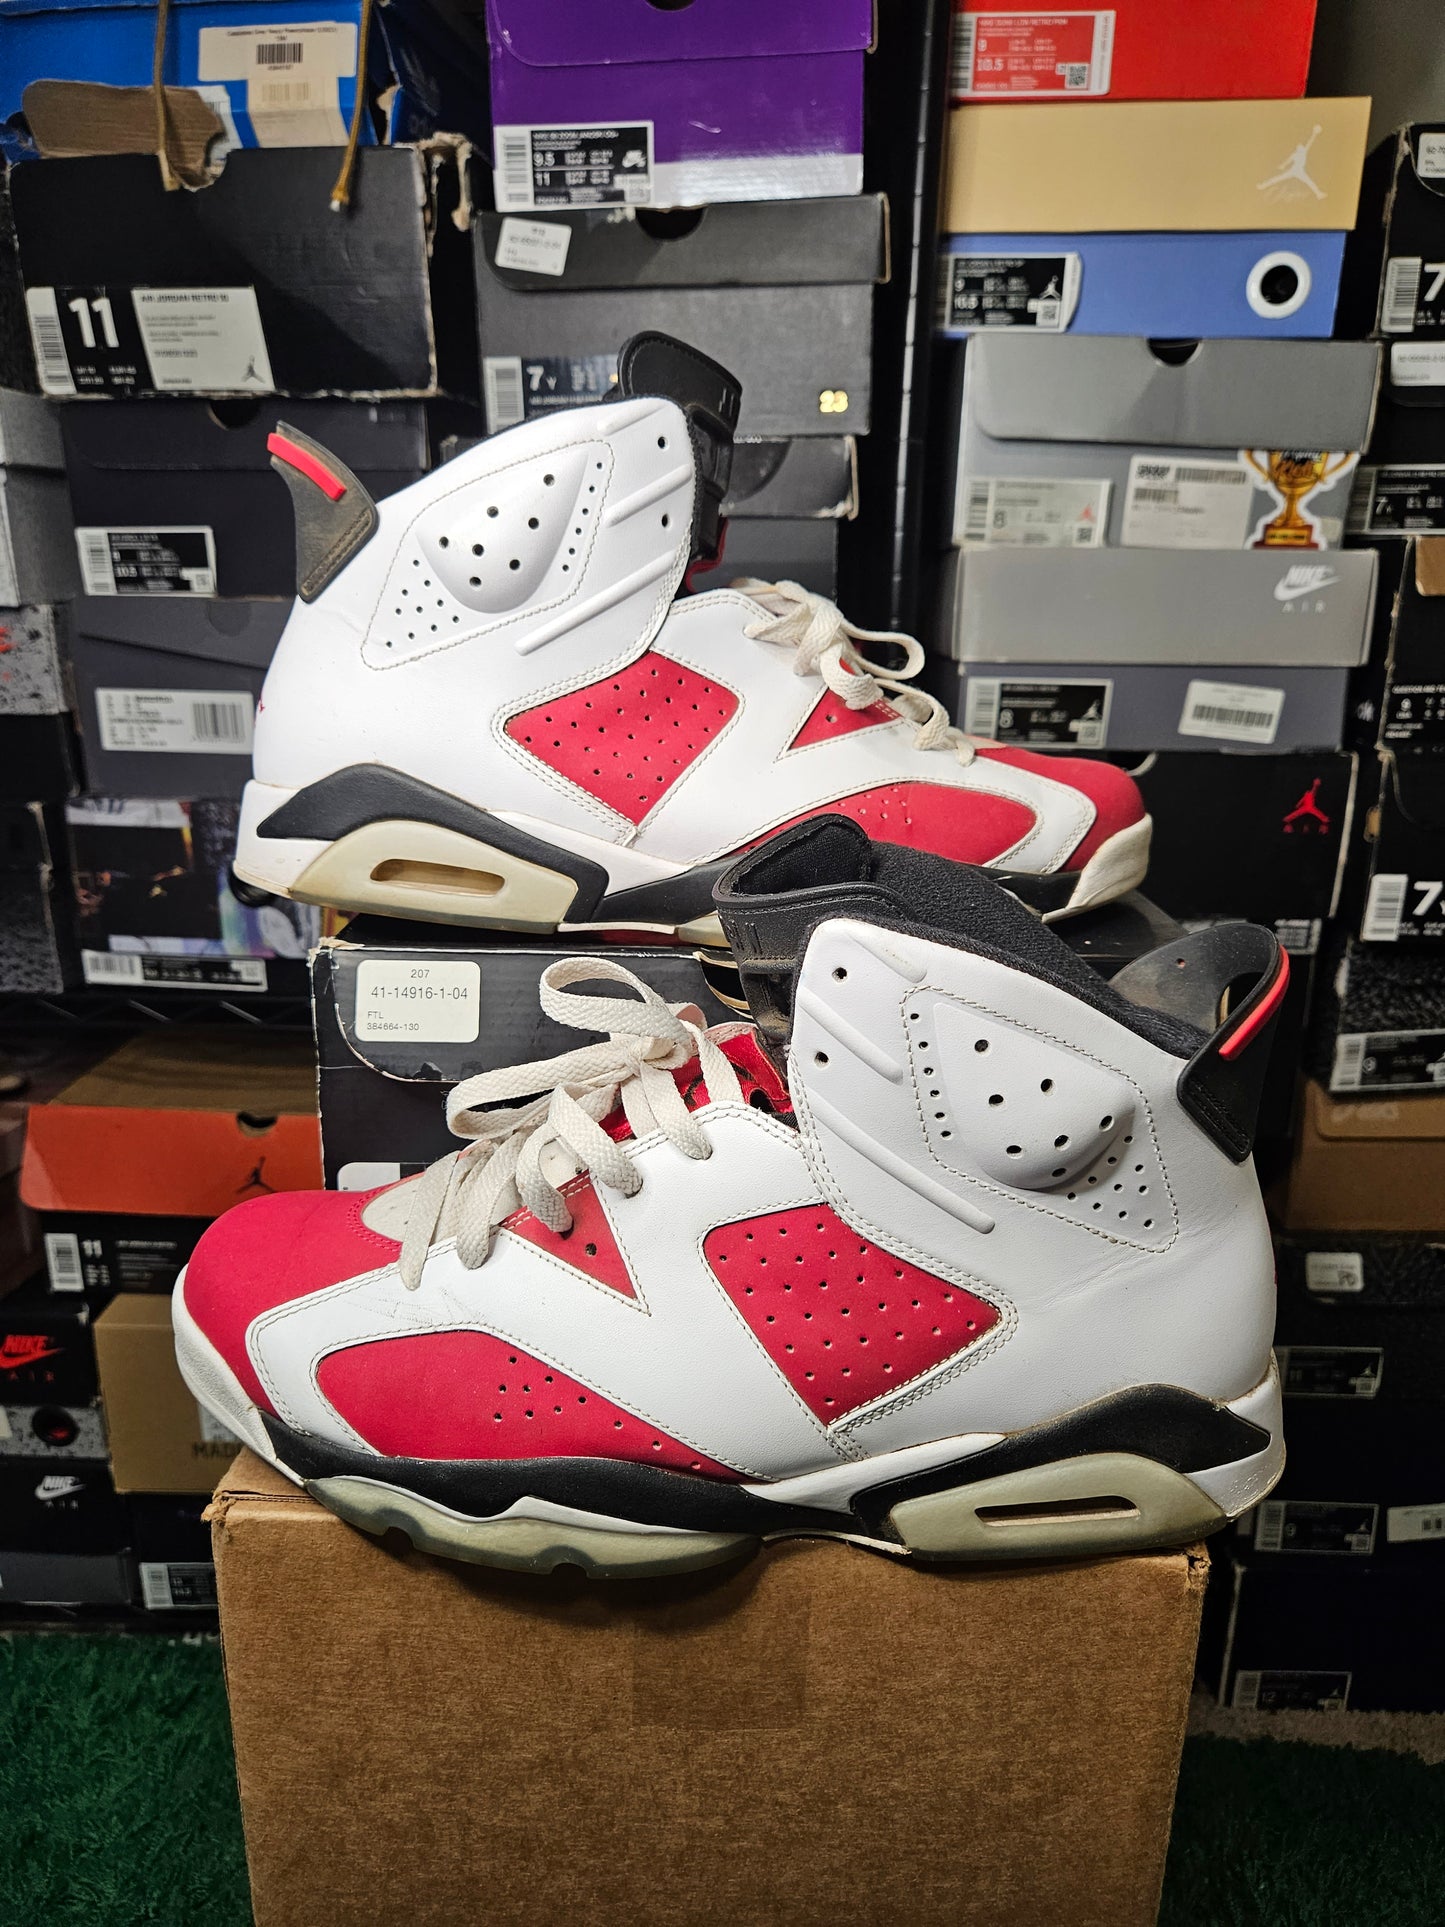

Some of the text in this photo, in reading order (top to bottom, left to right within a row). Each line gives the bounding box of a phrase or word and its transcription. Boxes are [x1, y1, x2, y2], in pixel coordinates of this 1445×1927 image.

[68, 297, 119, 348] 11
[1282, 601, 1327, 613] AIR
[410, 968, 430, 979] 207
[370, 985, 468, 1000] 41-14916-1-04
[367, 1011, 384, 1019] FTL
[366, 1023, 420, 1032] 384664-130
[3, 1335, 48, 1353] NIKE
